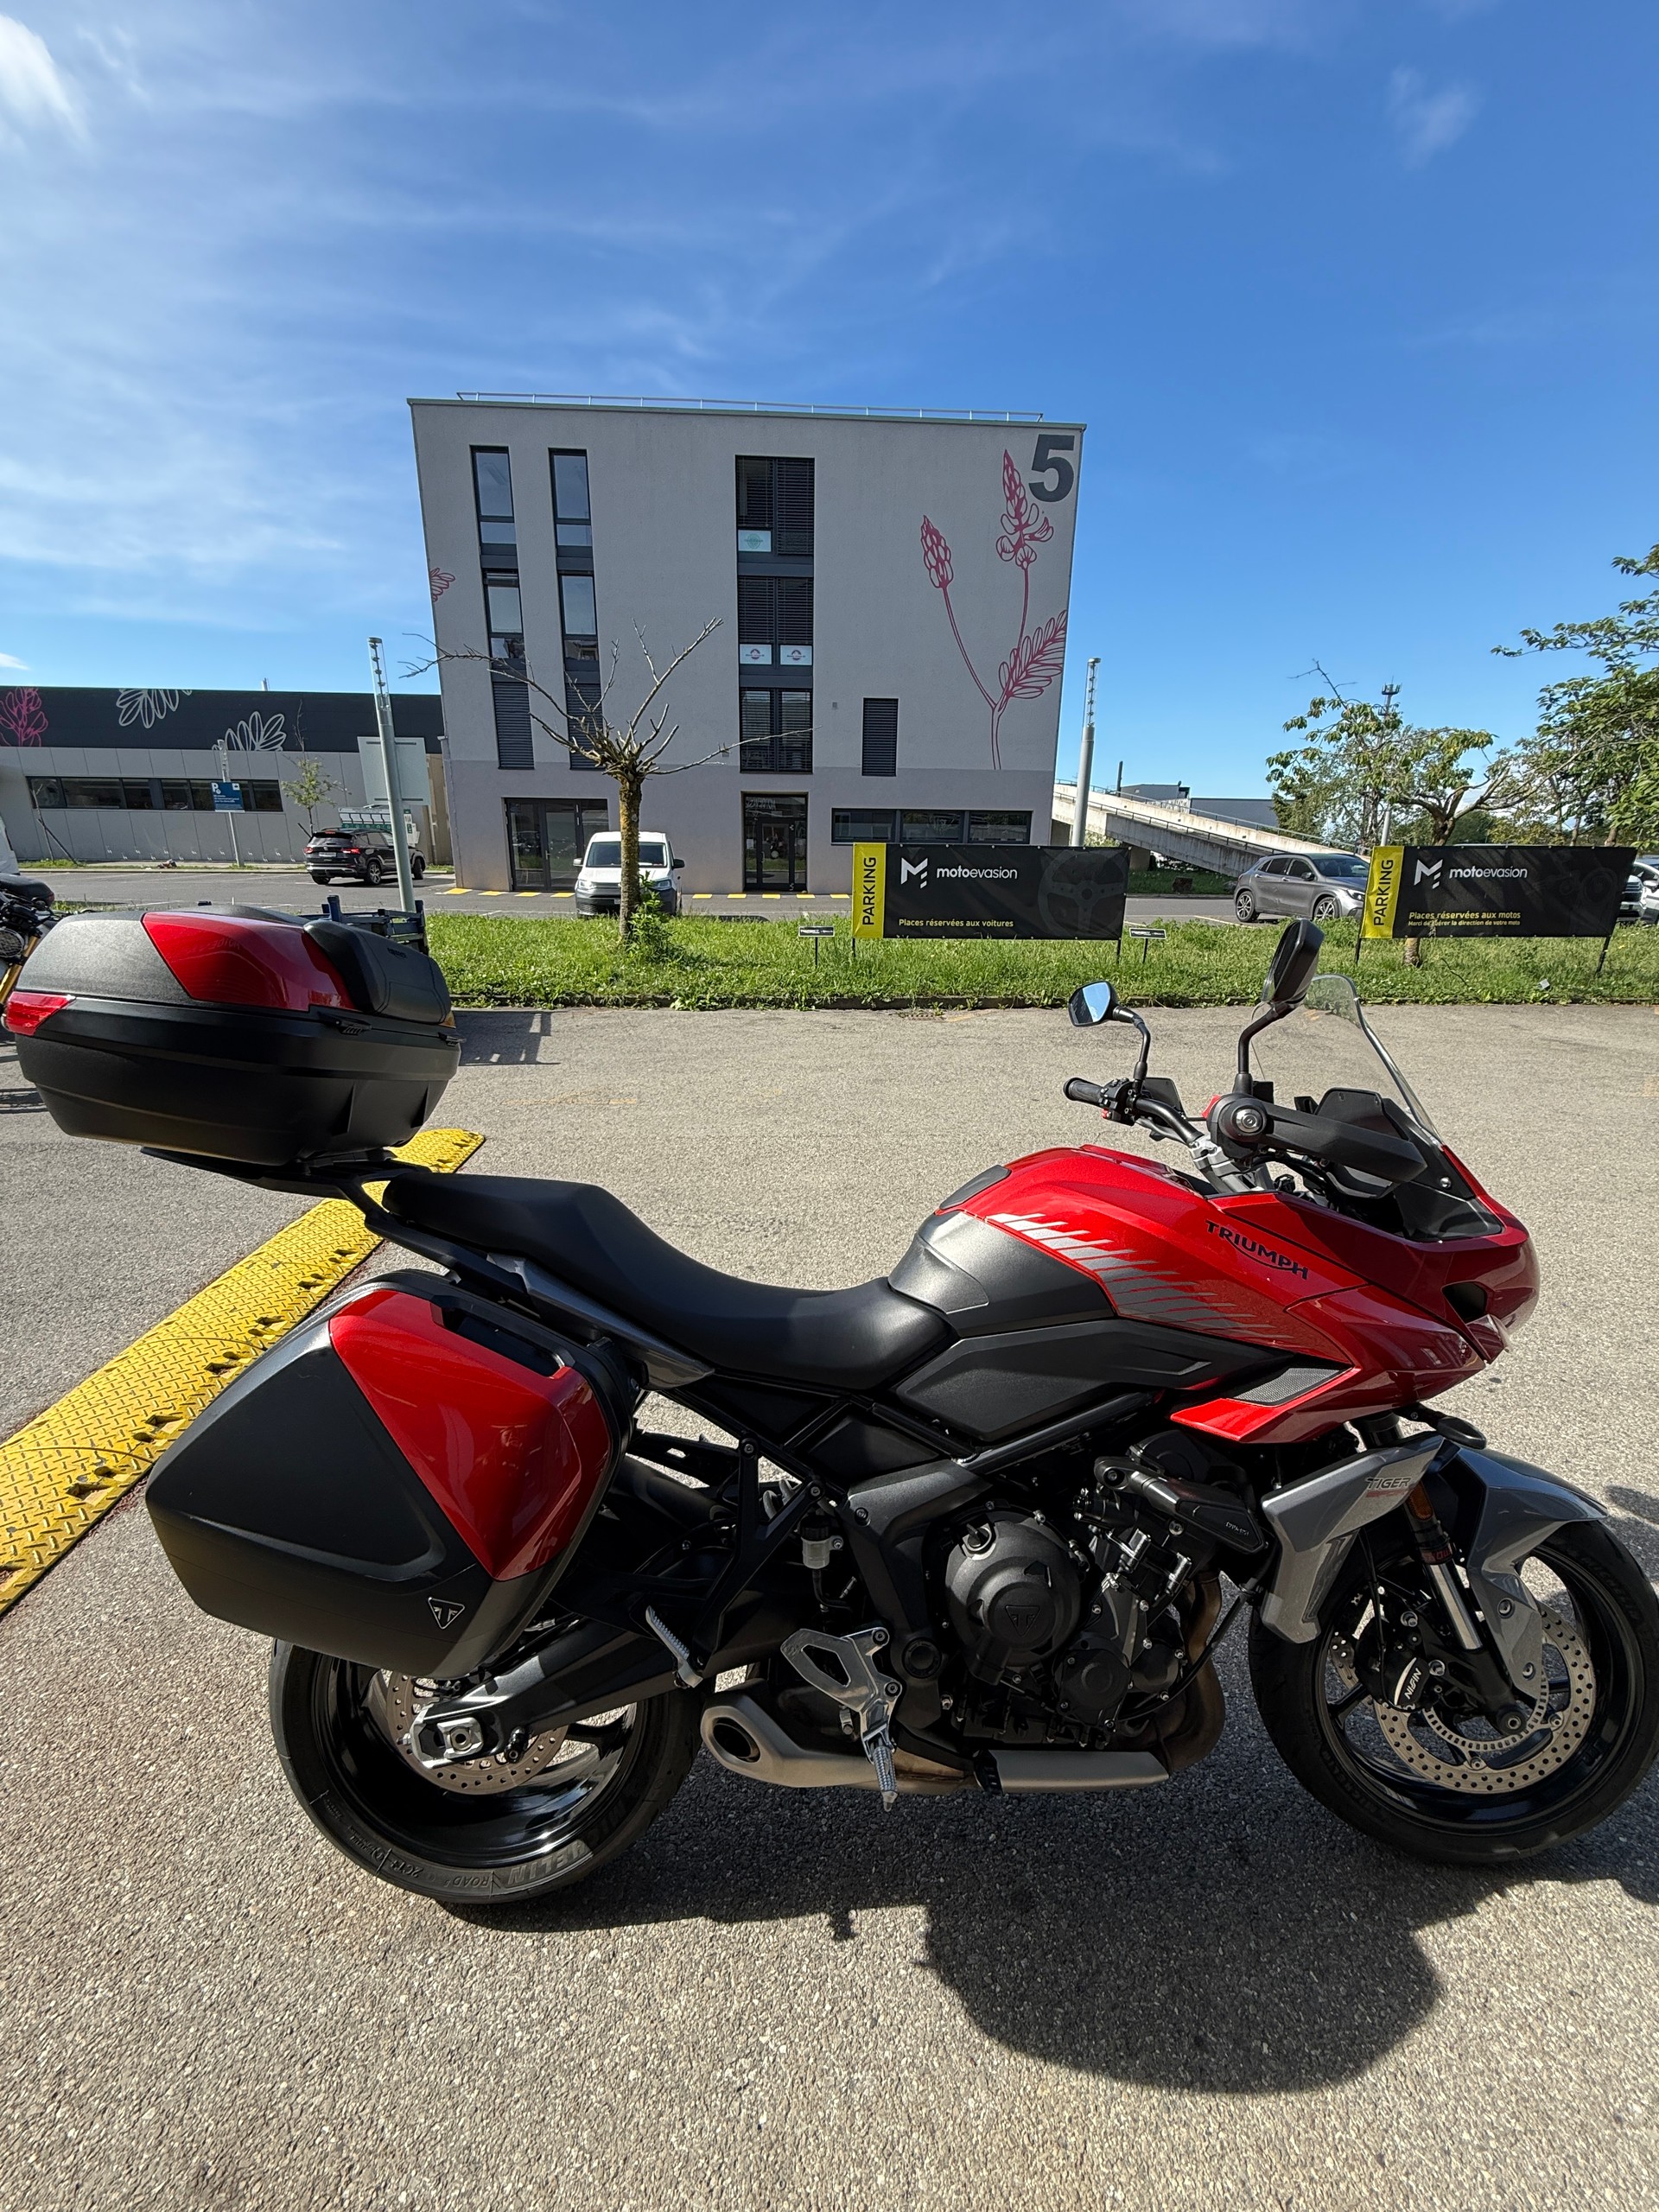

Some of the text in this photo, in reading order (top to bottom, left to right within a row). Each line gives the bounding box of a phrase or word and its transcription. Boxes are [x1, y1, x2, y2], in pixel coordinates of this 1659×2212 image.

[1028, 435, 1075, 502] 5
[936, 865, 1018, 880] motoevasion
[1449, 865, 1528, 880] motoevasion
[862, 857, 876, 925] PARKING
[1373, 859, 1394, 926] PARKING
[925, 918, 964, 927] réservées
[982, 918, 1014, 927] voitures
[1436, 910, 1480, 919] réservées
[1205, 1219, 1308, 1280] TRIUMPH
[1365, 1477, 1411, 1490] TIGER
[1404, 1668, 1421, 1700] NISSIN
